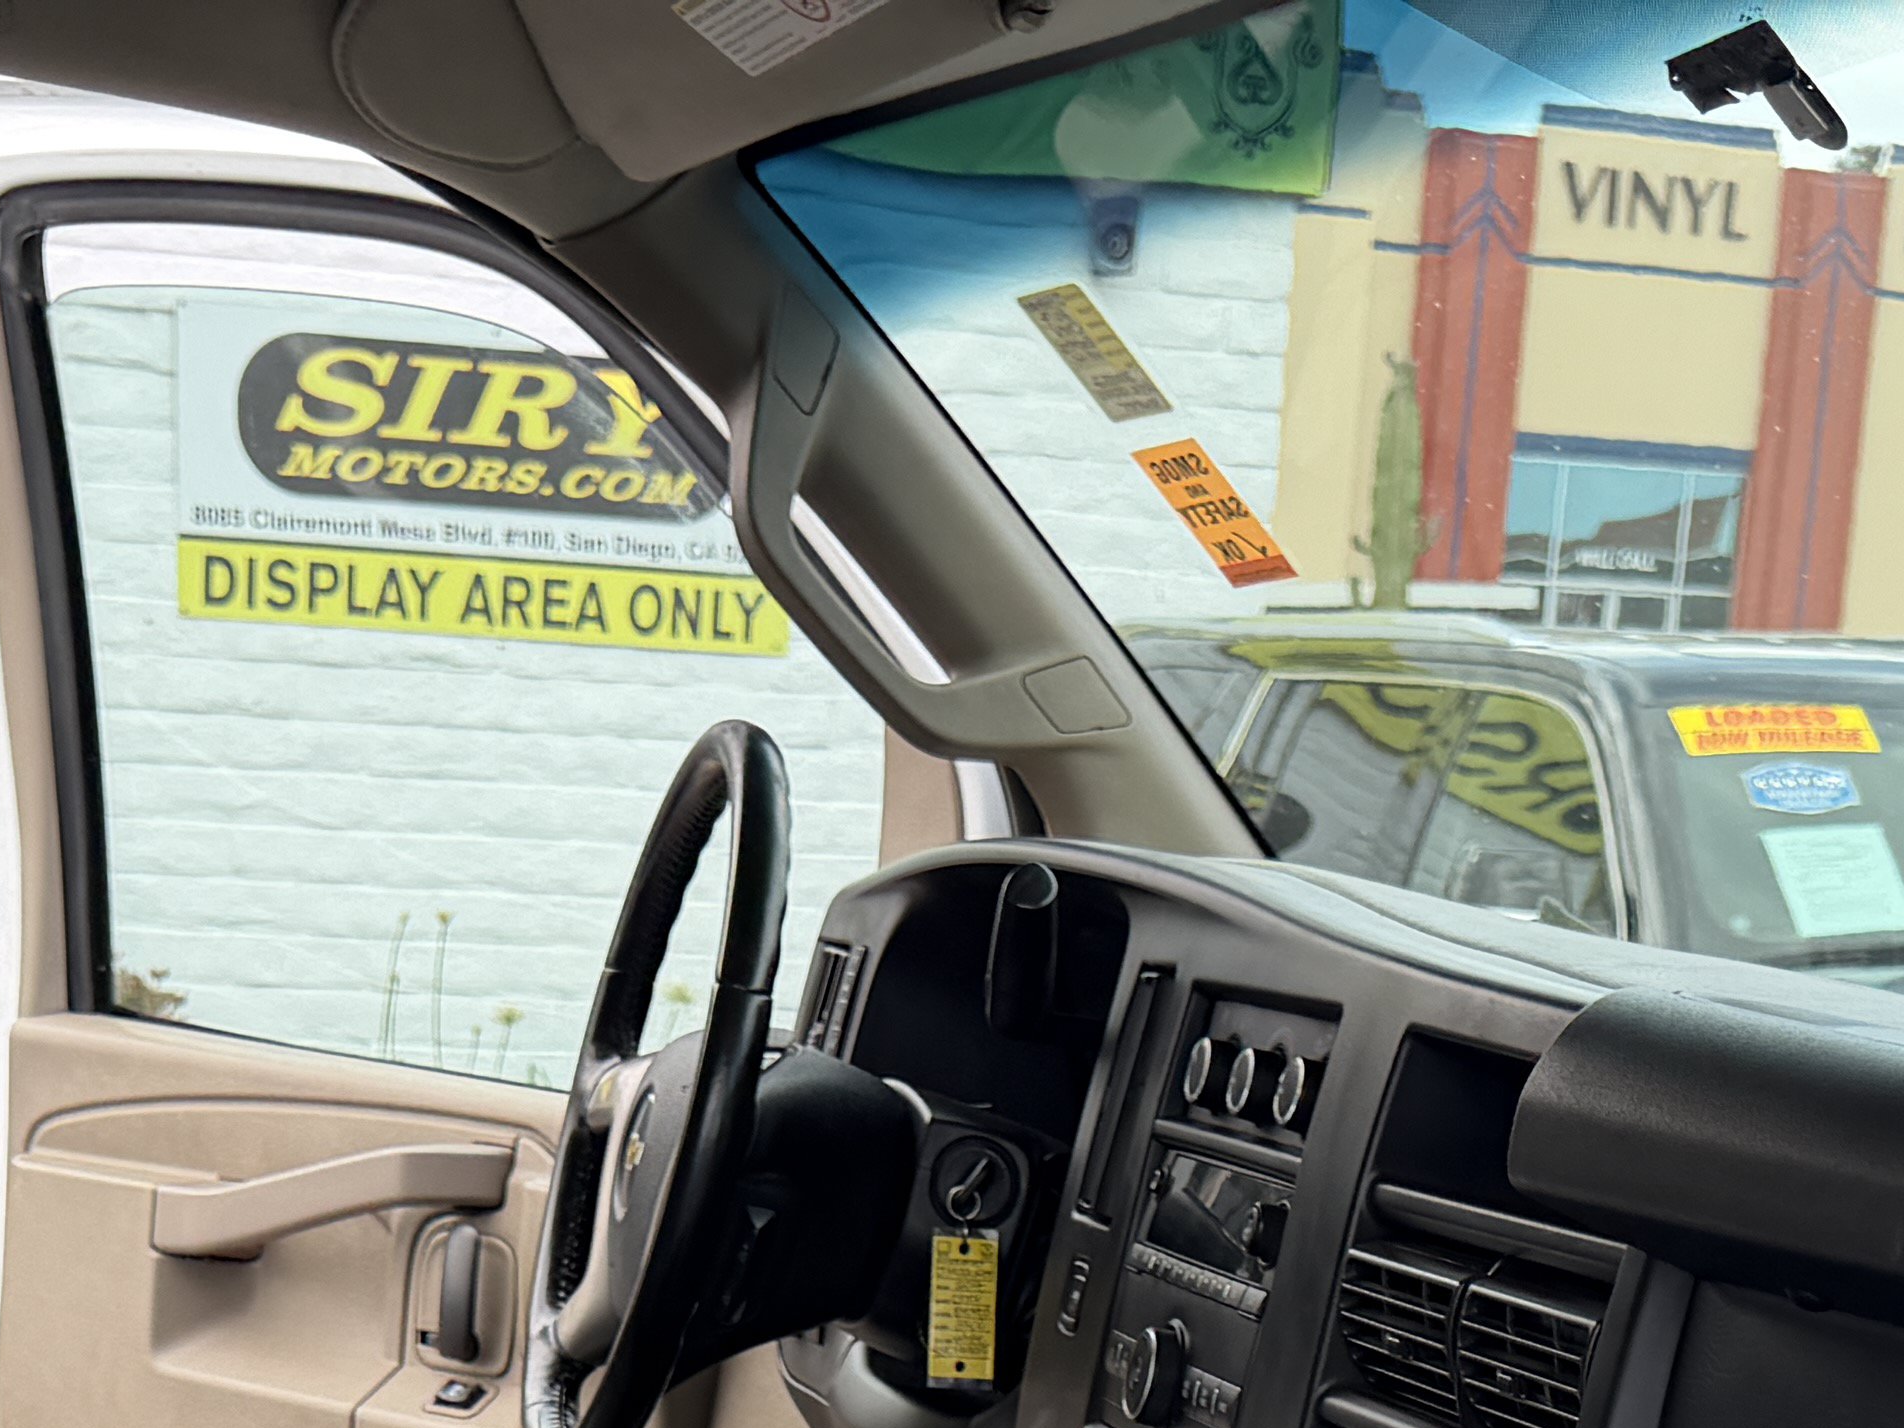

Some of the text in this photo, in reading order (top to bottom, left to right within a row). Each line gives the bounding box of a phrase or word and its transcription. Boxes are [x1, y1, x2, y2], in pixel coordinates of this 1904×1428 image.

[1561, 160, 1748, 241] VINYL
[275, 346, 662, 459] SIRY
[277, 441, 698, 507] MOTORS.COM
[203, 555, 765, 645] DISPLAY AREA ONLY
[1704, 706, 1838, 728] LOADED
